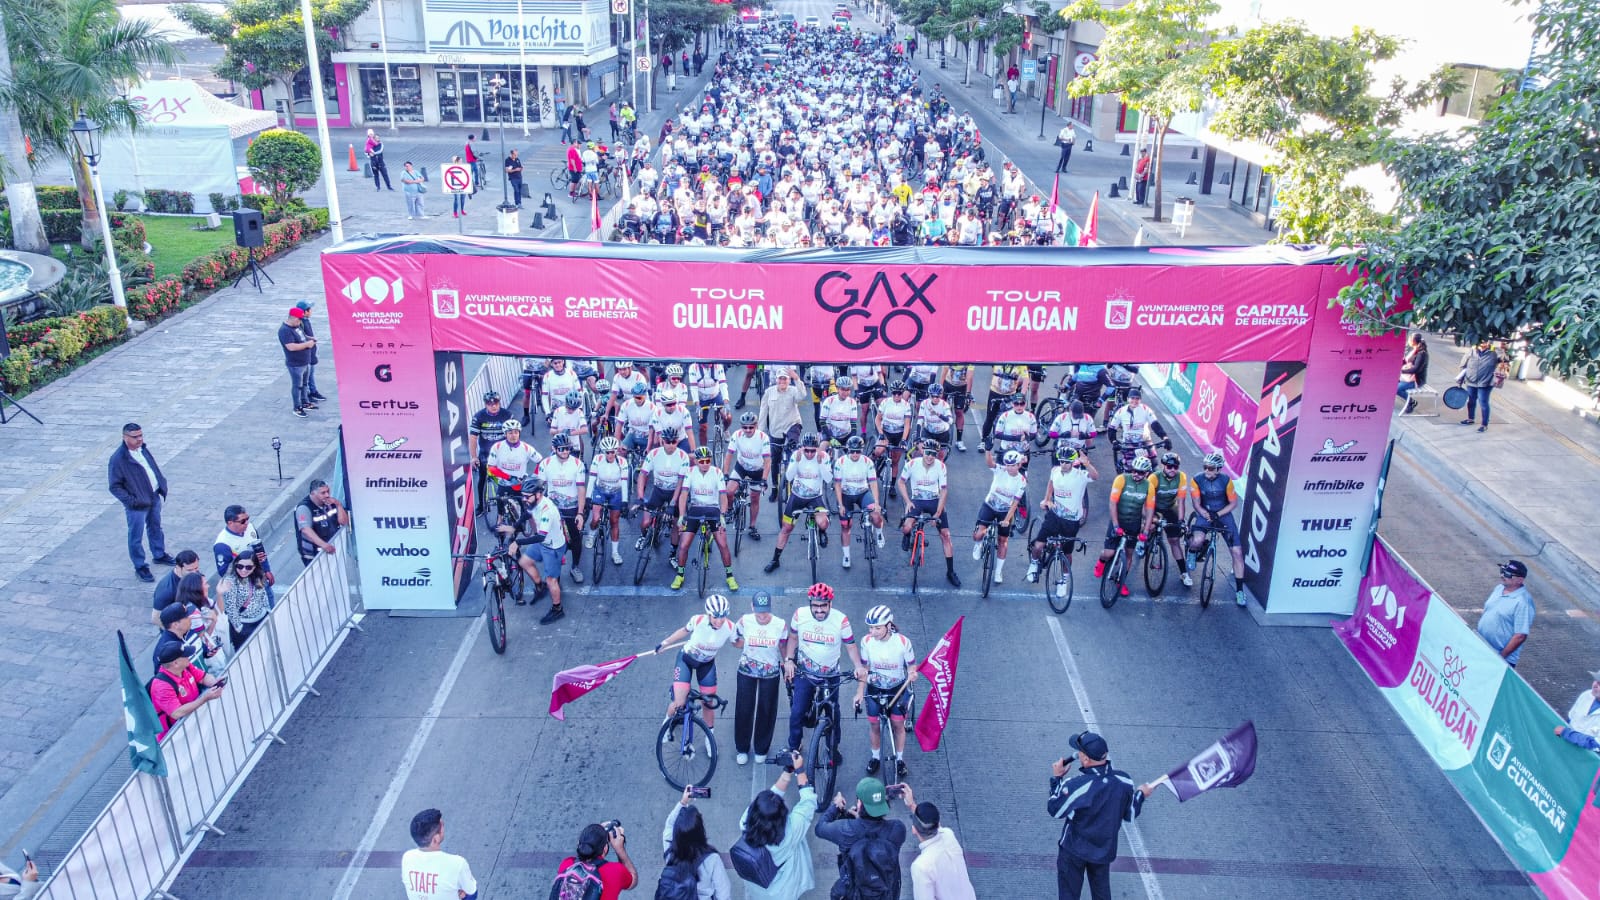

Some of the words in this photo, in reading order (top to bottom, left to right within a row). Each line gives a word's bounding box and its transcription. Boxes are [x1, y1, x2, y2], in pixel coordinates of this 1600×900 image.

[488, 16, 582, 43] Ponchito
[690, 287, 765, 300] TOUR
[814, 270, 939, 314] GAX
[986, 290, 1061, 302] TOUR
[464, 294, 538, 303] AYUNTAMIENTO
[539, 296, 552, 304] DE
[564, 296, 640, 311] CAPITAL
[566, 310, 580, 318] DE
[582, 310, 638, 319] BIENESTAR
[1137, 304, 1210, 312] AYUNTAMIENTO
[1211, 304, 1224, 312] DE
[1236, 304, 1309, 317] CAPITAL
[673, 302, 783, 330] CULIACAN
[966, 305, 1078, 331] CULIACAN
[1235, 317, 1249, 326] DE
[1251, 317, 1307, 326] BIENESTAR
[834, 308, 924, 350] GO
[359, 399, 419, 410] certus
[1319, 403, 1378, 413] certus
[1310, 455, 1367, 463] MICHELIN
[365, 477, 428, 488] infinibike
[1244, 384, 1288, 574] SALIDA
[1303, 480, 1365, 491] infinibike
[373, 517, 428, 529] THULE
[1301, 518, 1353, 531] THULE
[376, 543, 430, 557] wahoo
[1296, 545, 1347, 558] wahoo
[1510, 756, 1557, 808] AYUNTAMIENTO
[1556, 805, 1568, 820] DE
[409, 870, 439, 895] STAFF
